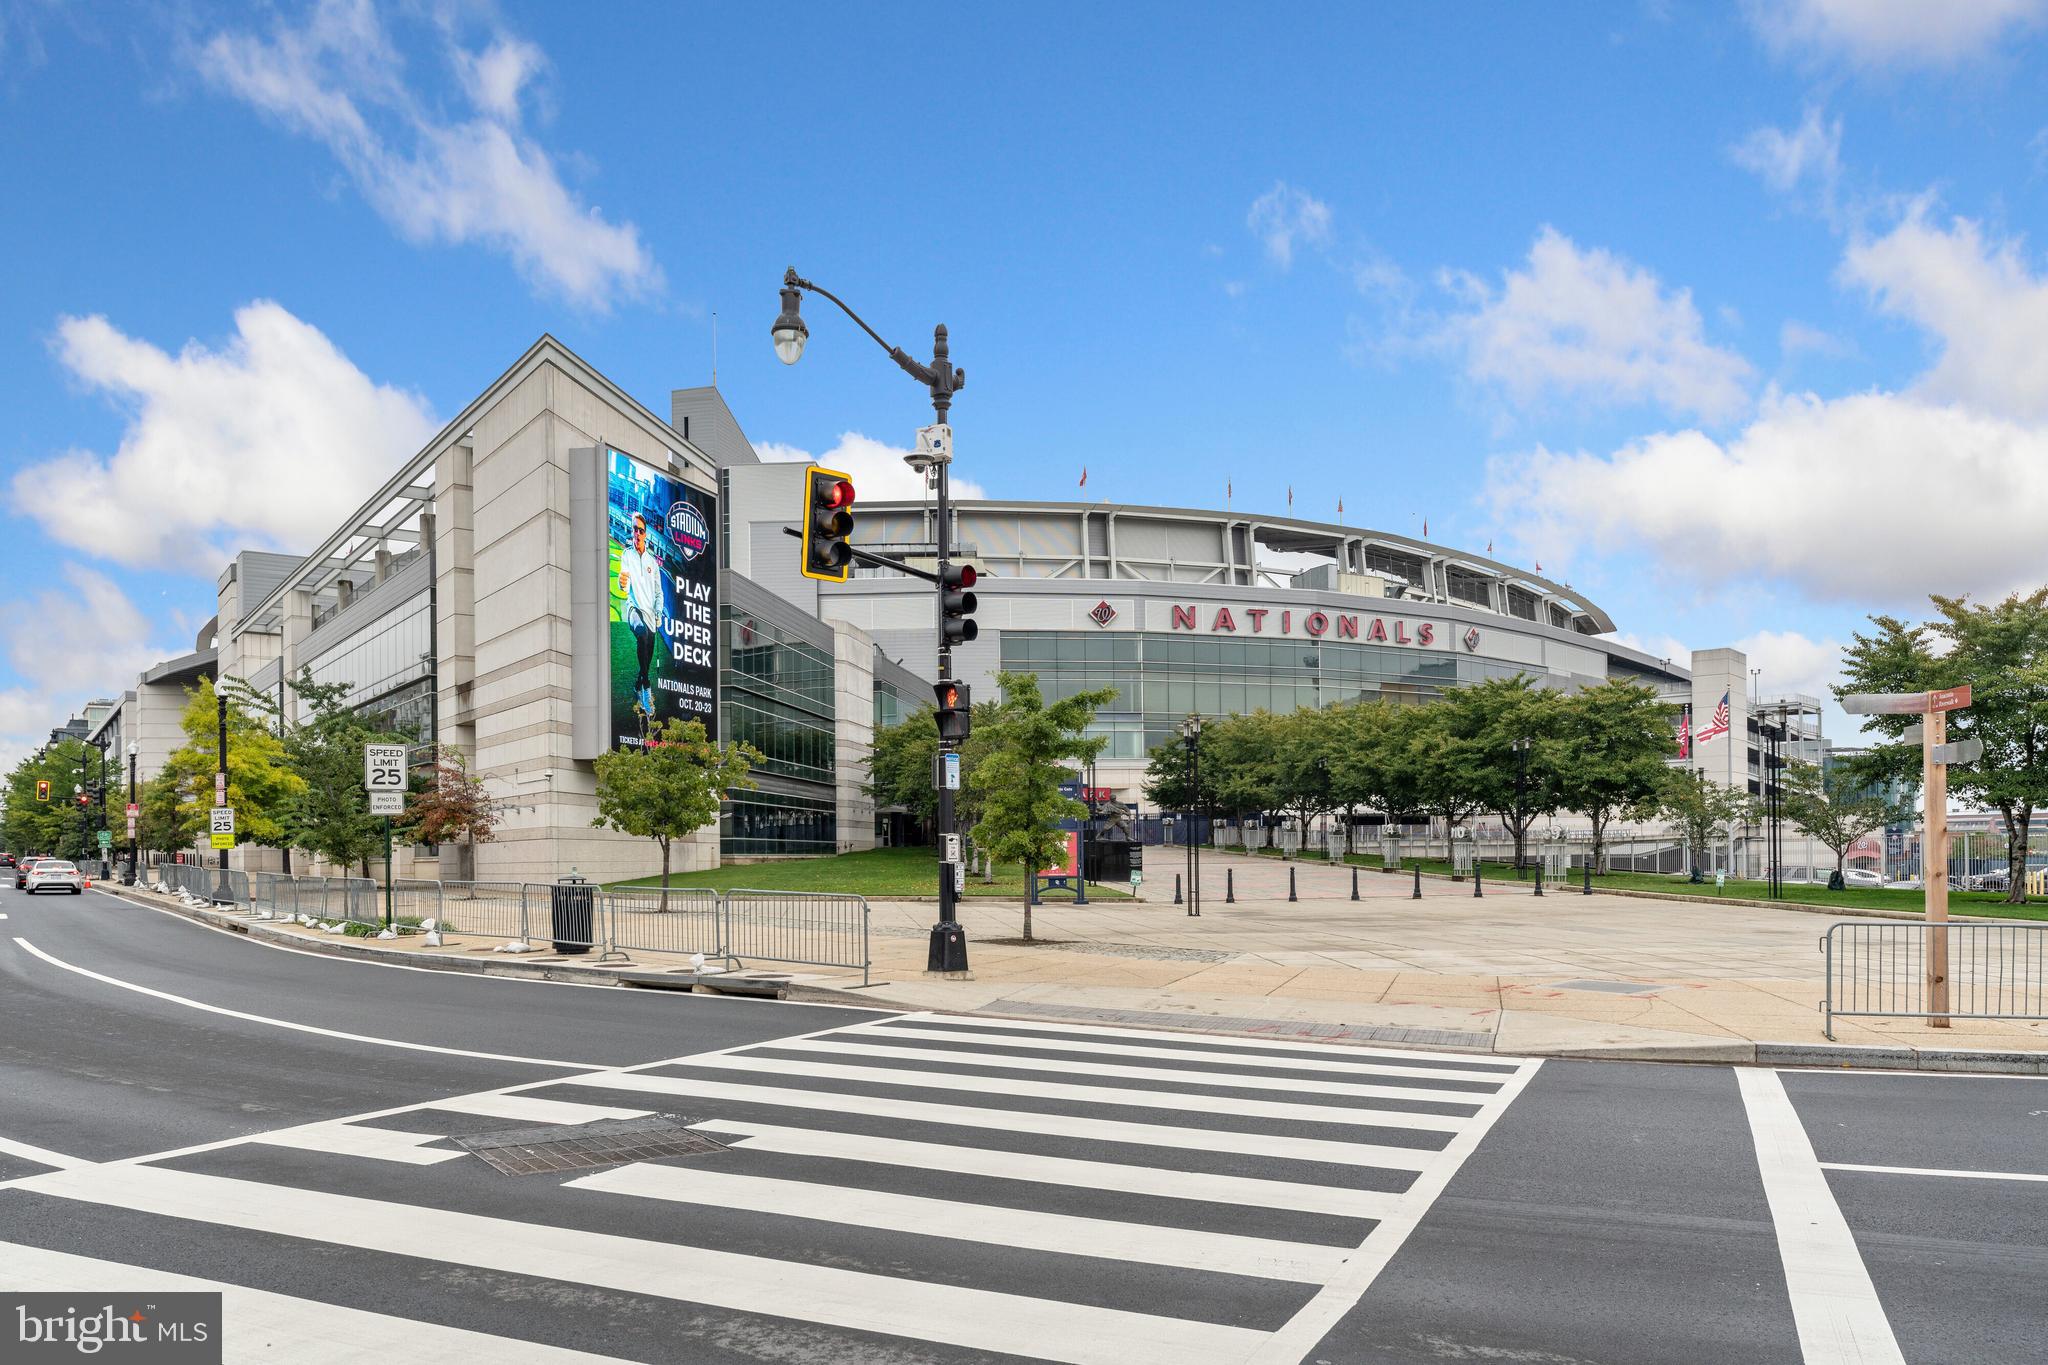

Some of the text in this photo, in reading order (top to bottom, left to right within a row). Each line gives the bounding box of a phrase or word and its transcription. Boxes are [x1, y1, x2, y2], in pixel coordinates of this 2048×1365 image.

[671, 512, 706, 540] STADIUM
[675, 531, 702, 550] LINKS
[676, 576, 711, 603] PLAY
[683, 600, 711, 625] THE
[664, 617, 712, 646] UPPER
[1172, 604, 1434, 645] NATIONALS
[673, 642, 712, 668] DECK
[657, 678, 712, 699] NATIONALS PARK
[678, 698, 712, 714] OCT. 20-23
[619, 735, 639, 745] TICKETS
[369, 748, 404, 757] SPEED
[373, 758, 399, 767] LIMIT
[371, 768, 402, 786] 25
[213, 821, 232, 832] 25
